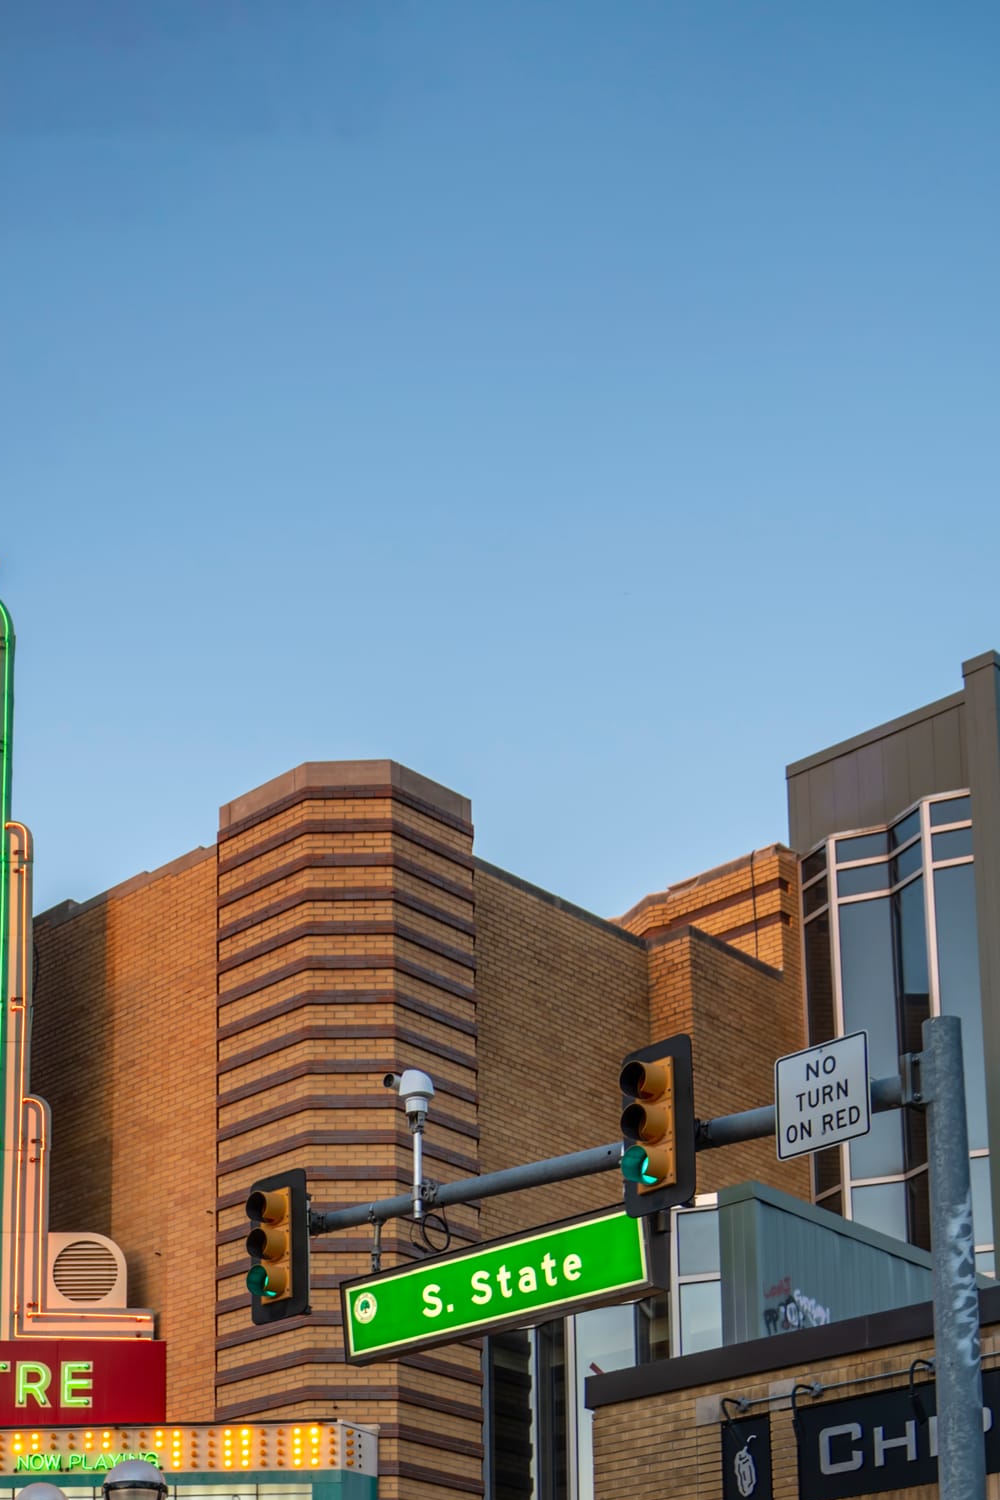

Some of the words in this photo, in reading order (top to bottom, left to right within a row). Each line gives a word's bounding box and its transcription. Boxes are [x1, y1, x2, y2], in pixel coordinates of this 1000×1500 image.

[806, 1056, 836, 1081] NO
[796, 1079, 848, 1112] TURN
[786, 1120, 812, 1143] ON
[822, 1106, 860, 1131] RED
[422, 1284, 454, 1318] S.
[471, 1252, 582, 1305] State
[17, 1454, 62, 1471] NOW
